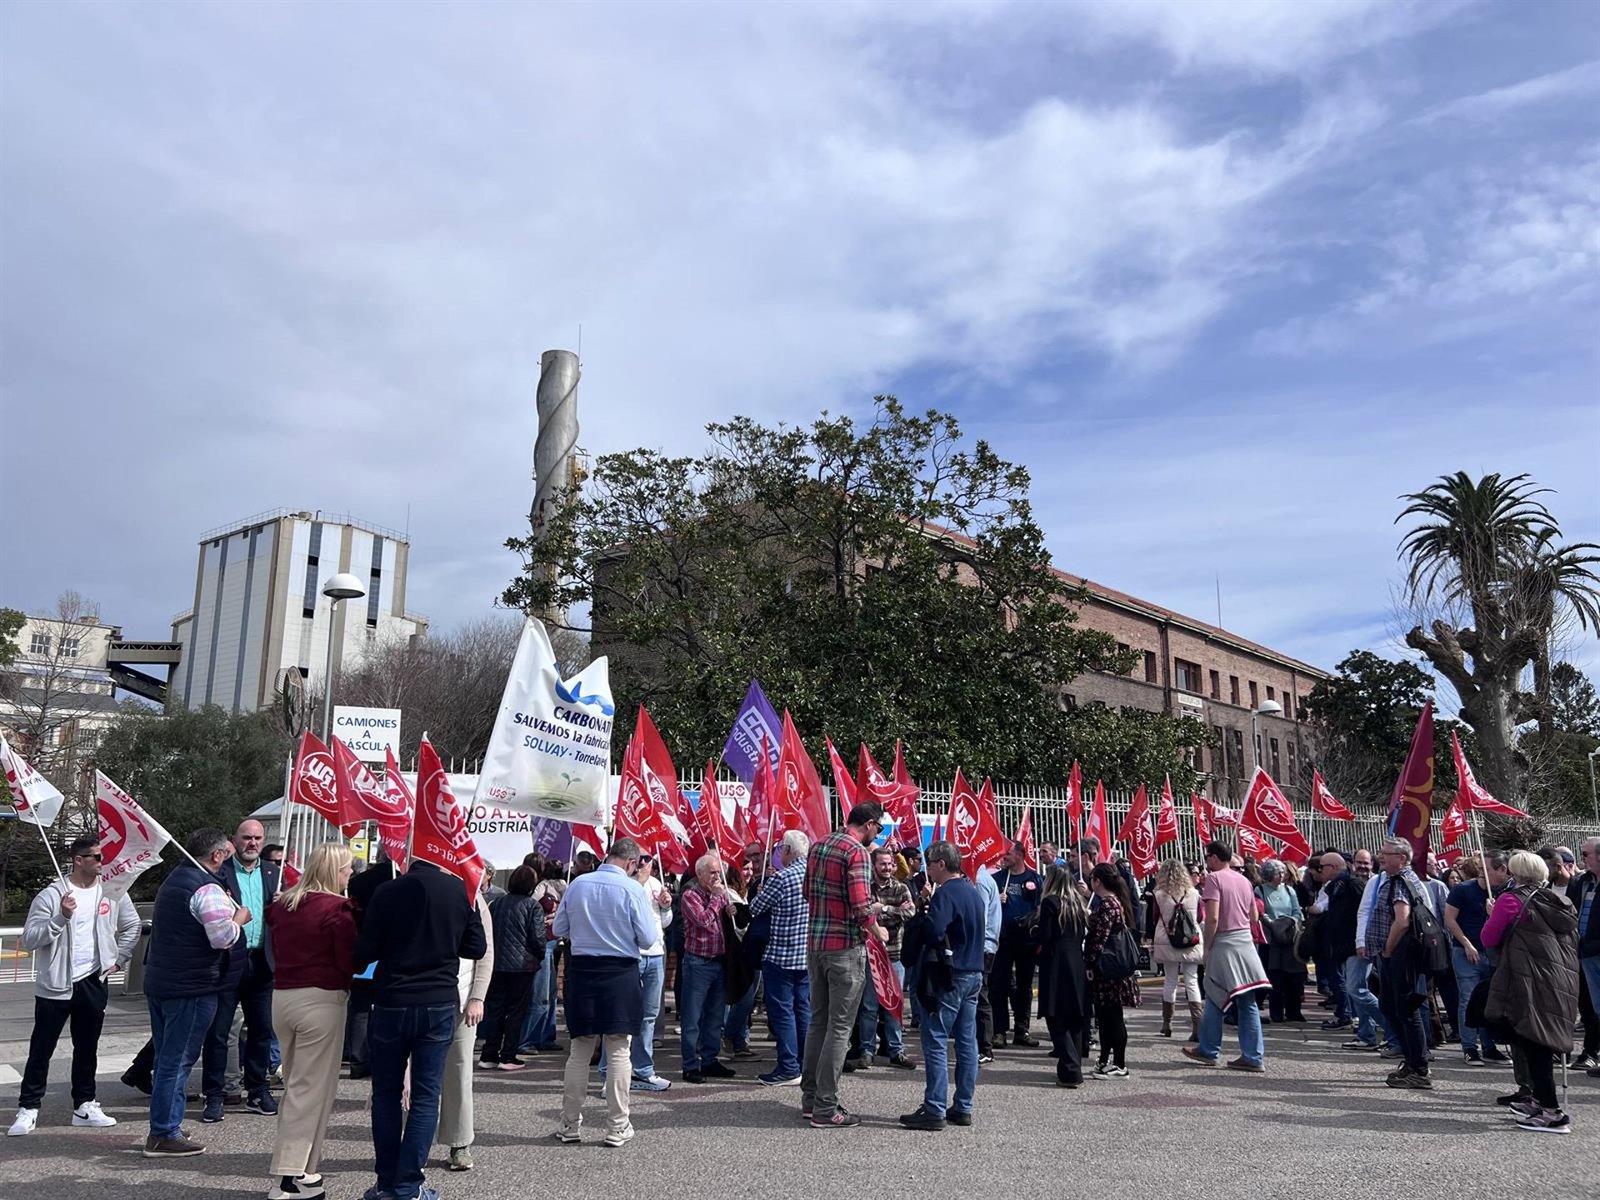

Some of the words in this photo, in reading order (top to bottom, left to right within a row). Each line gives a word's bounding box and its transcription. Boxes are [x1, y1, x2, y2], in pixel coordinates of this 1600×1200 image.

[336, 716, 398, 729] CAMIONES
[513, 712, 570, 740] SALVEMOS
[572, 731, 583, 744] la
[362, 730, 372, 739] A
[342, 738, 392, 751] ÁSCULA
[523, 735, 568, 757] SOLVAY
[309, 758, 336, 794] UG
[719, 784, 746, 796] USO
[468, 821, 533, 834] DUSTRIA
